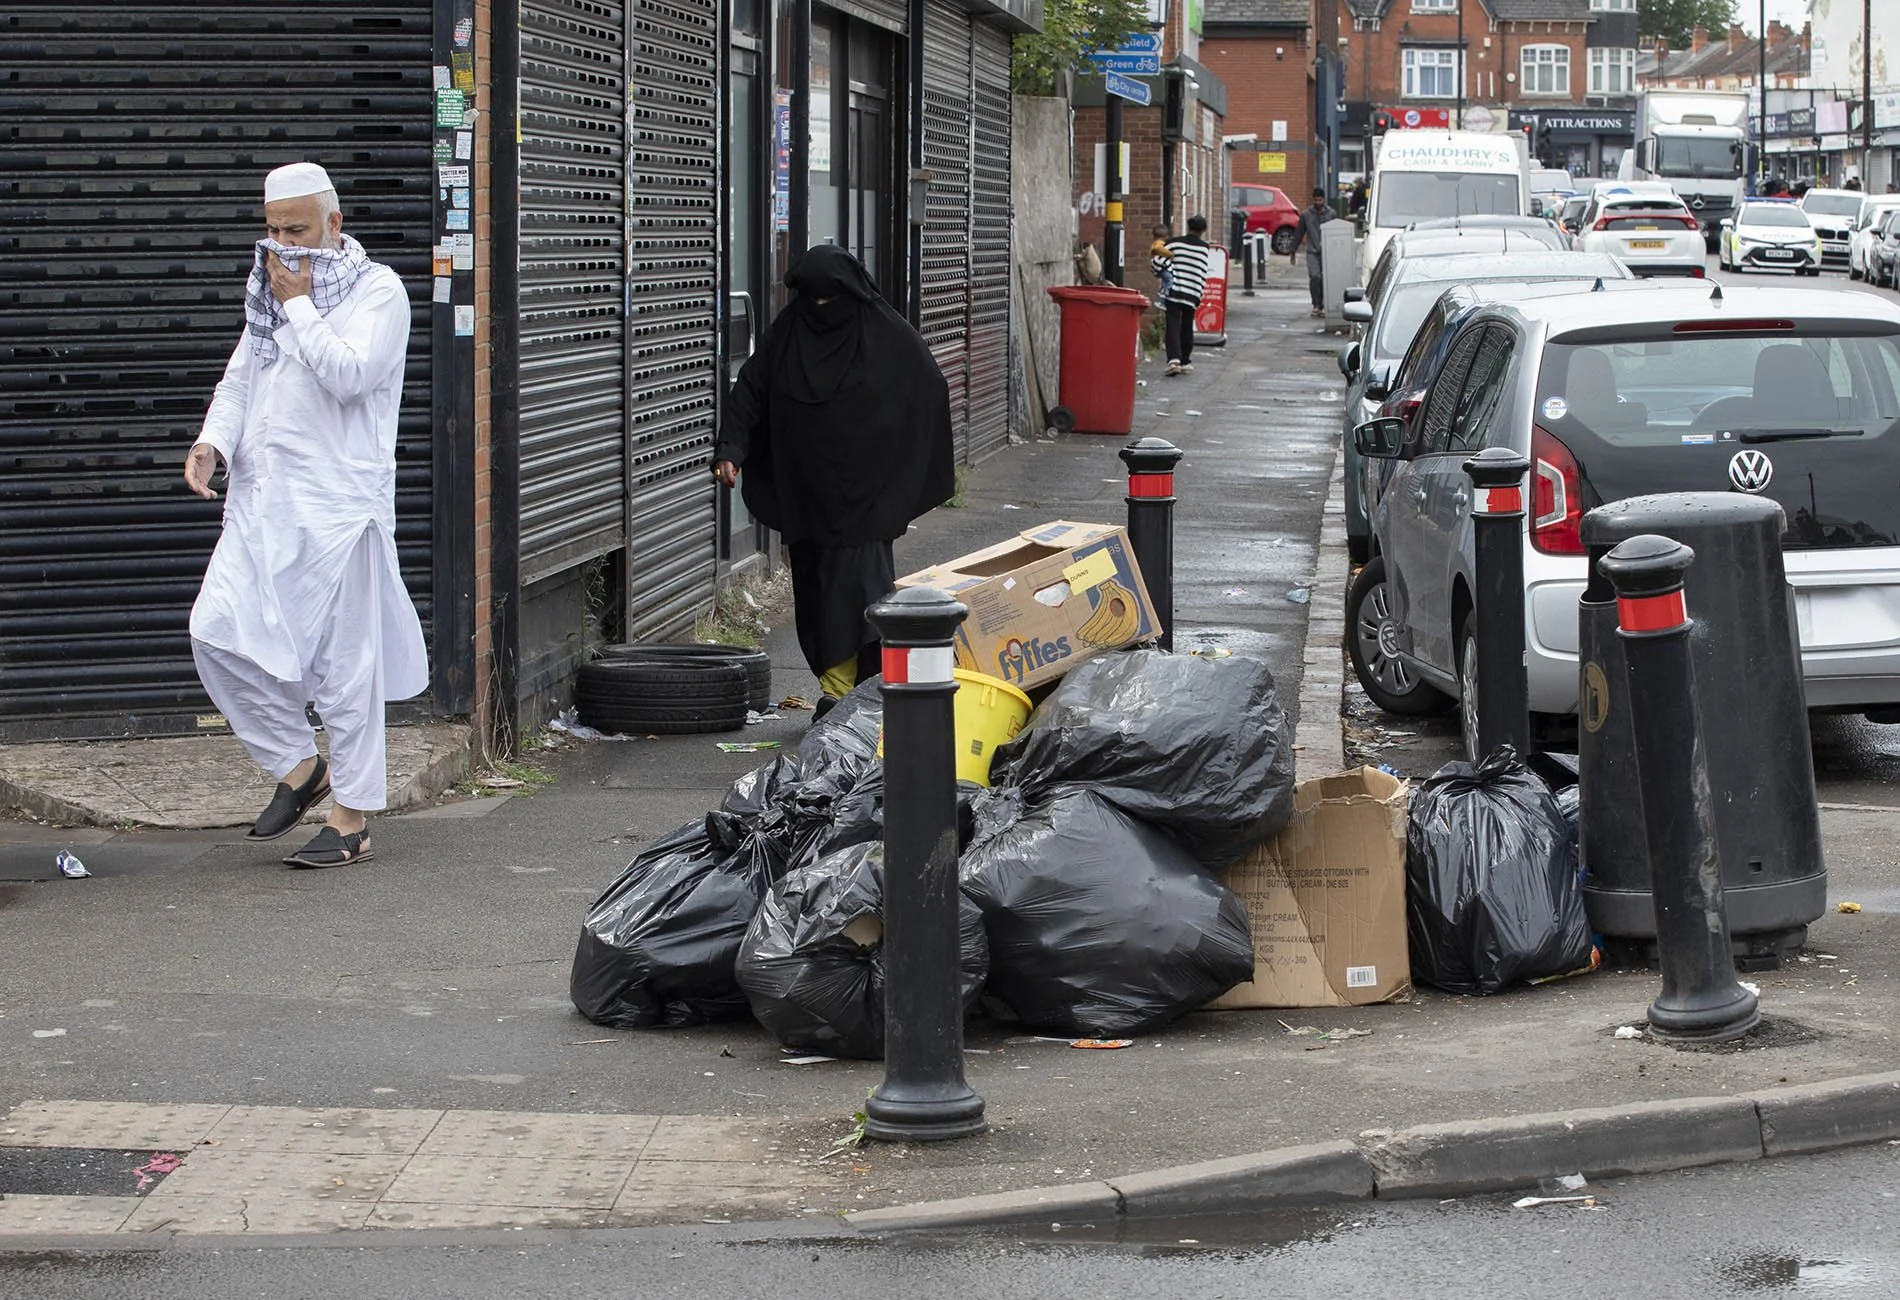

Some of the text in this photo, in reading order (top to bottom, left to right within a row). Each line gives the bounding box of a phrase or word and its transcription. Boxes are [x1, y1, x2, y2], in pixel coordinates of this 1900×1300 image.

[1106, 60, 1133, 68] Green
[1120, 82, 1129, 93] City
[1545, 118, 1622, 128] ATTRACTIONS
[1388, 148, 1510, 163] CHAUDHRY'S
[1403, 159, 1436, 167] CASH
[1455, 160, 1494, 168] CARRY
[999, 636, 1072, 683] fyffes
[1273, 913, 1298, 921] CREAM
